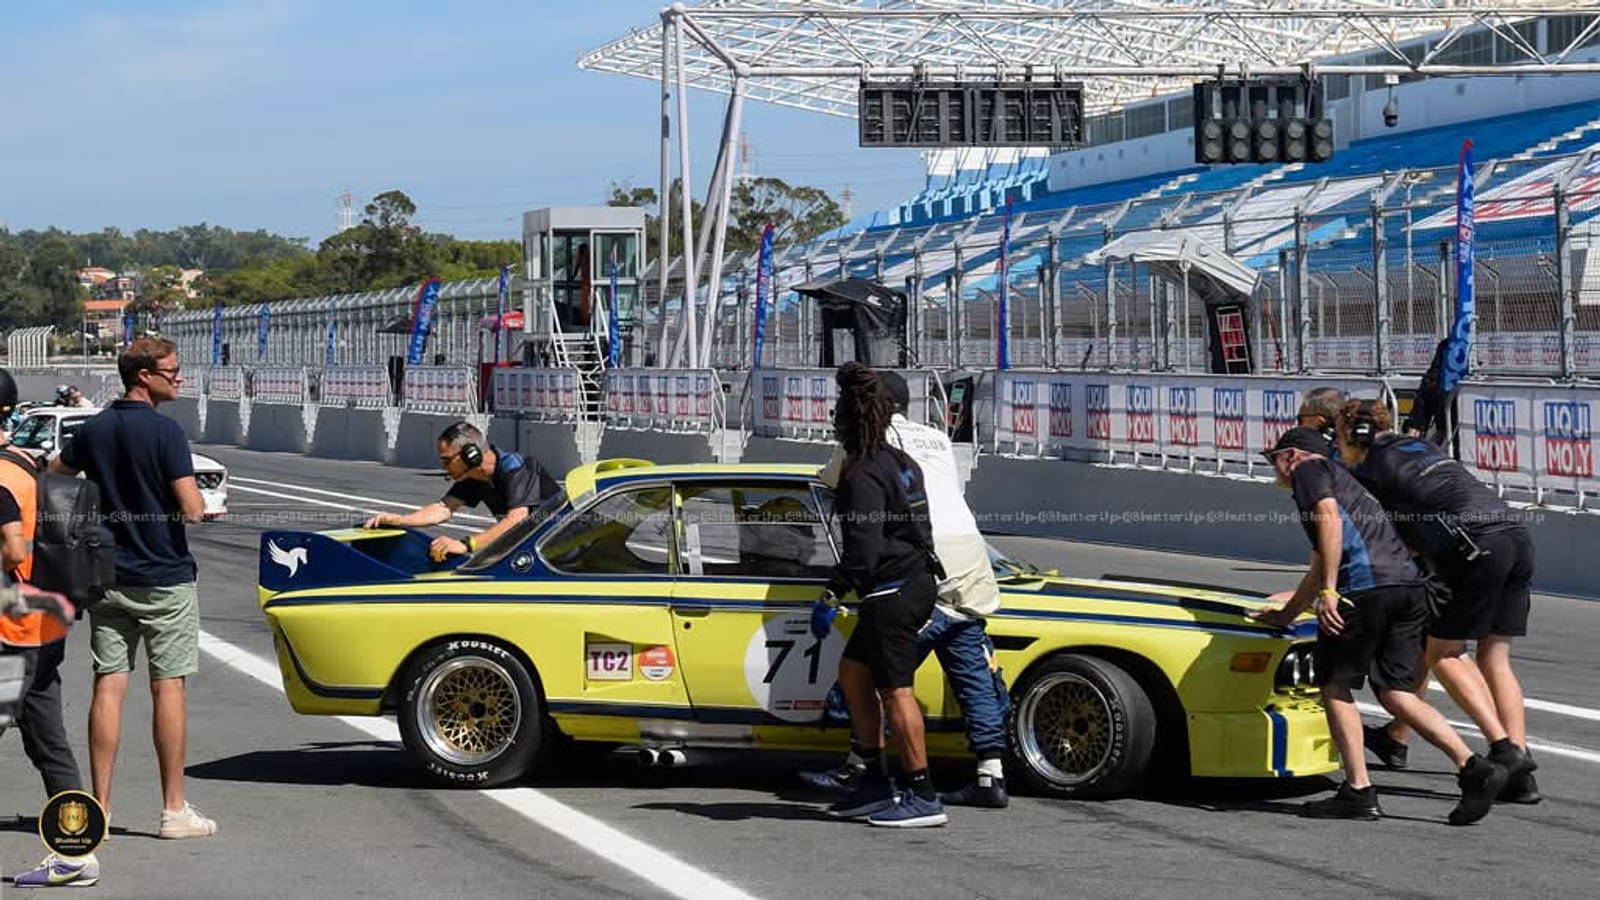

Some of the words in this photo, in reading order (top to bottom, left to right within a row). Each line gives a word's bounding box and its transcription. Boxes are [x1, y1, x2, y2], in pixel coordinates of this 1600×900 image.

[1215, 420, 1245, 447] MOLY
[1475, 402, 1515, 434] LIQUI
[1476, 436, 1516, 470] MOLY
[1547, 441, 1591, 476] MOLY
[590, 650, 629, 673] TC2
[762, 640, 823, 685] 71
